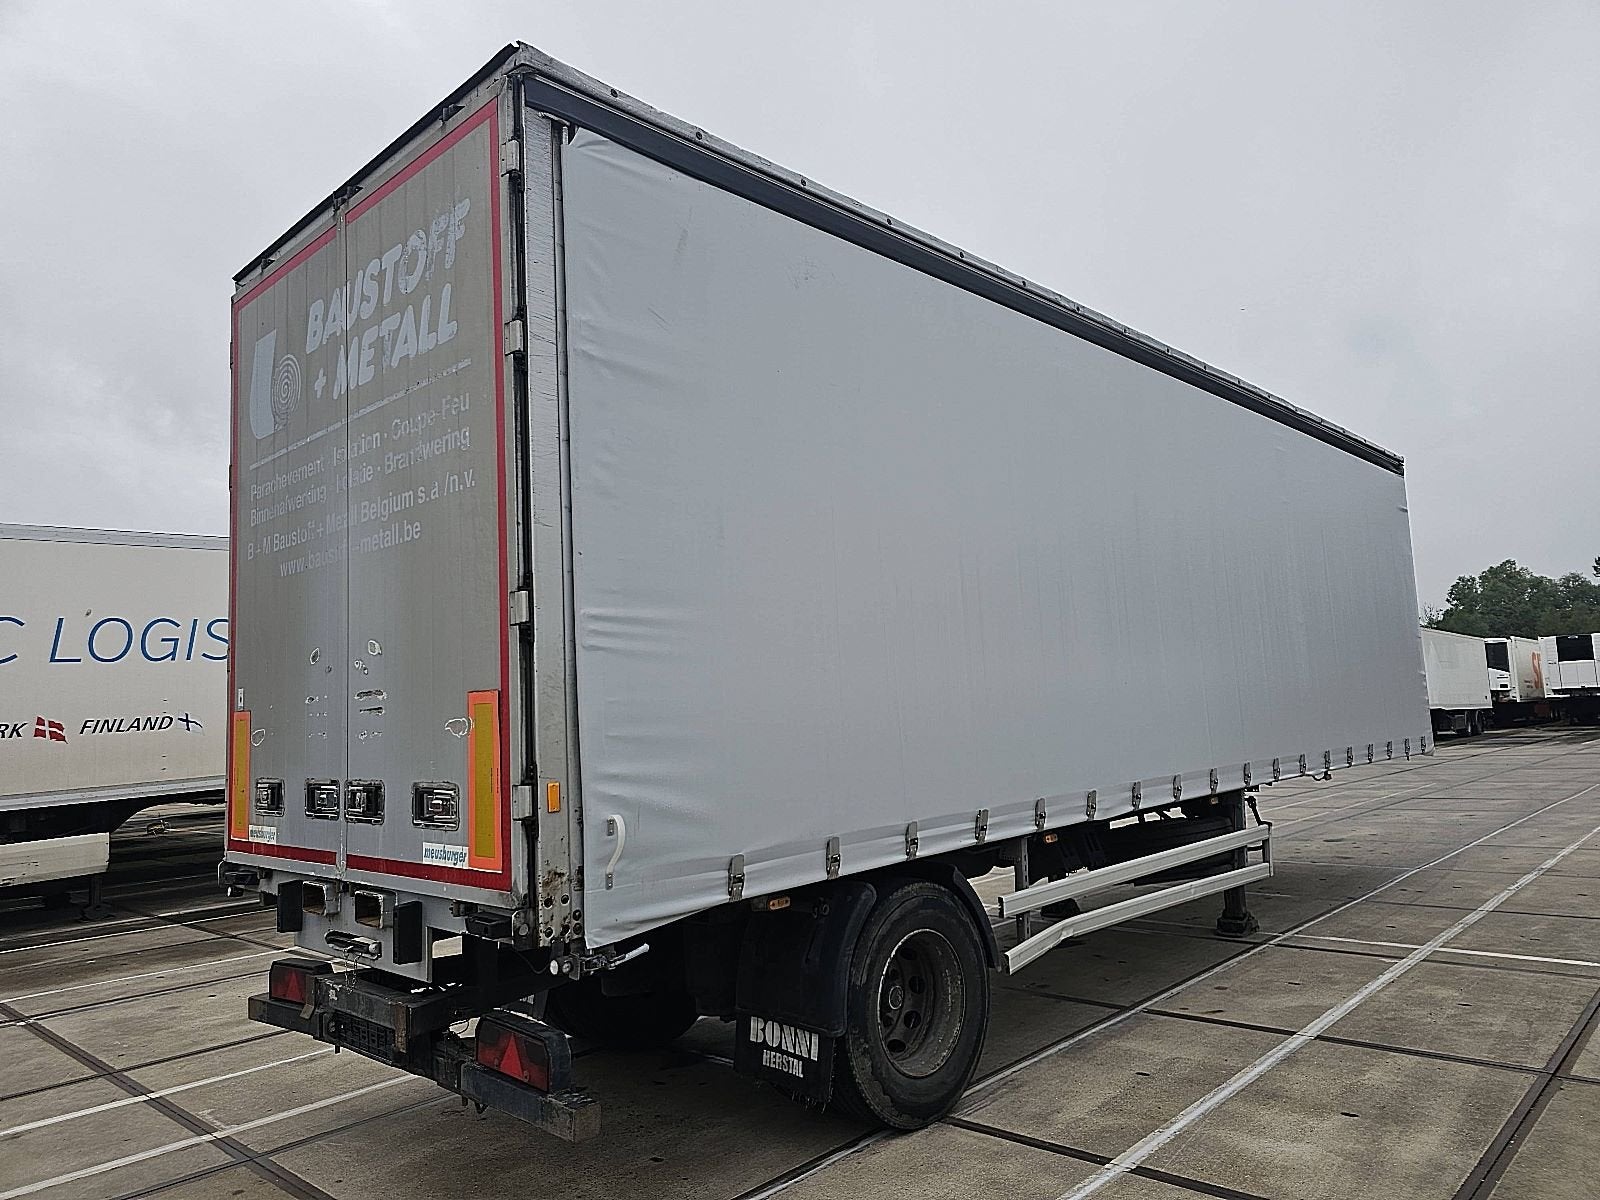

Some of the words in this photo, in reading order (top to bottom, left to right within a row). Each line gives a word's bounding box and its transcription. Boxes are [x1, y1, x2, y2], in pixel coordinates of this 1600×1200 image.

[306, 199, 471, 354] BAUSTOFF
[333, 283, 458, 400] METALL
[361, 492, 414, 523] Belgium
[49, 616, 229, 663] LOGIS
[79, 715, 174, 735] FINLAND
[424, 846, 467, 866] meusburger
[750, 1016, 819, 1062] BONNI
[762, 1049, 804, 1078] HERSTAL
